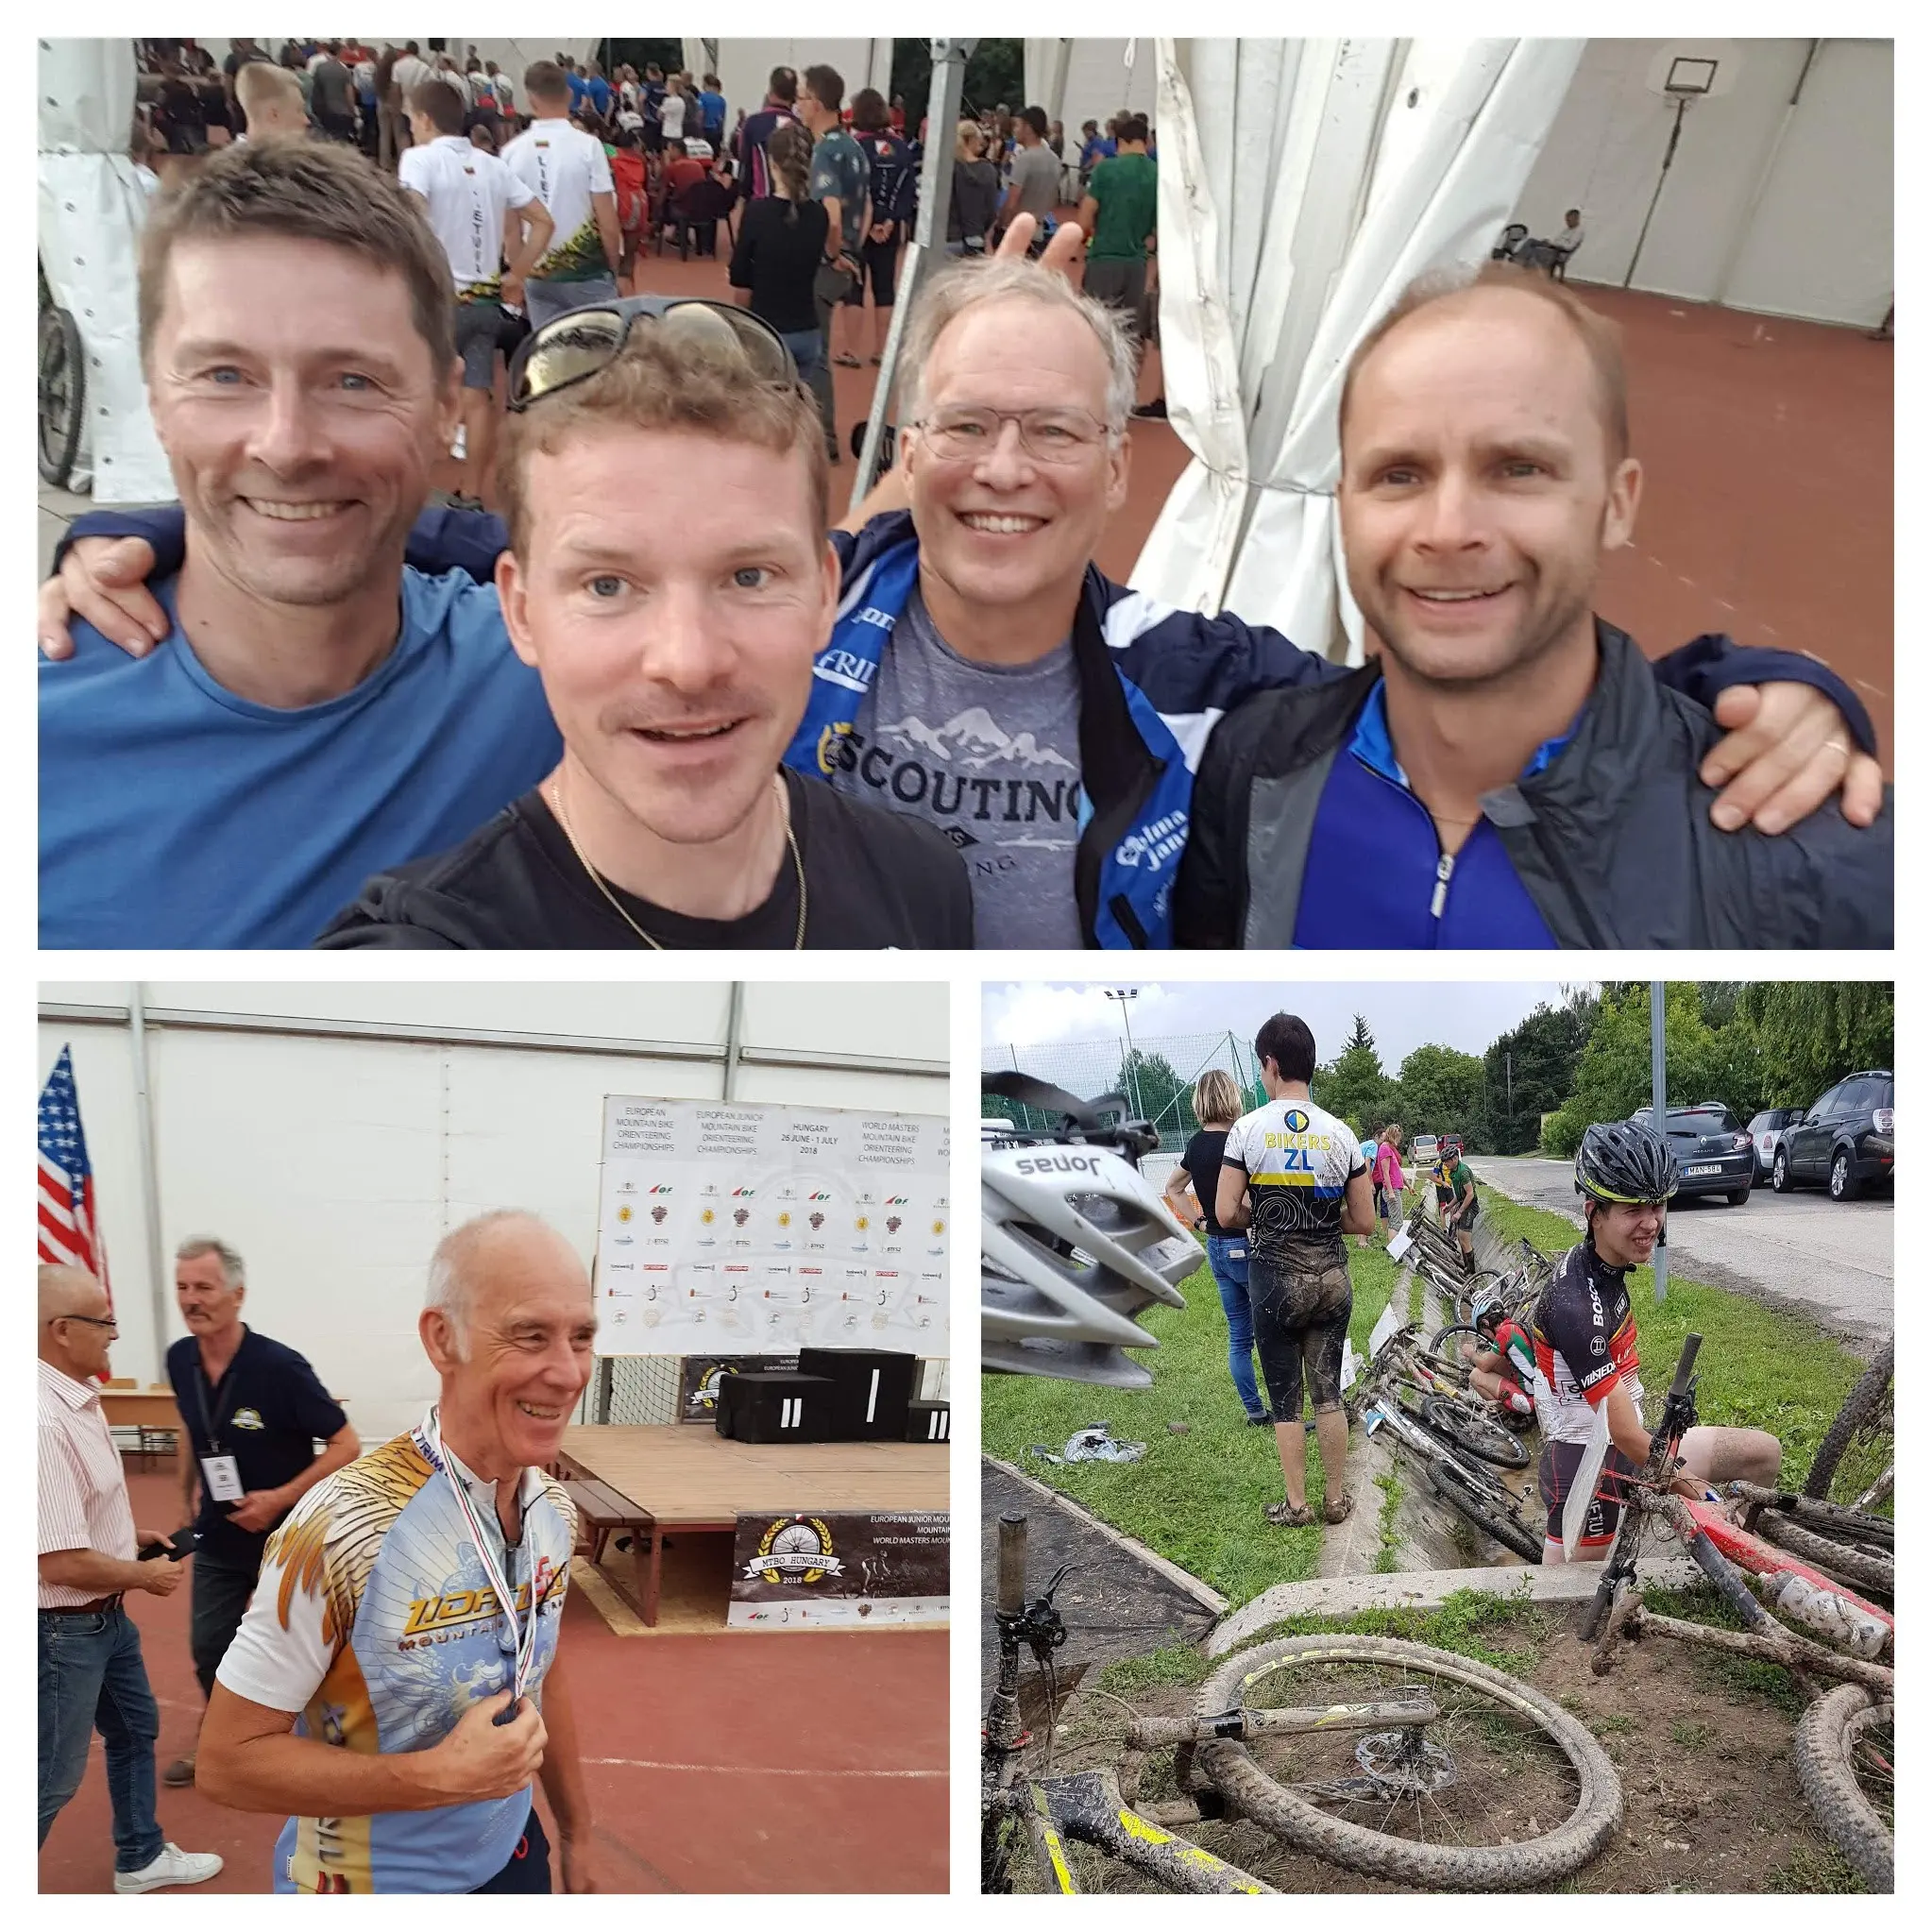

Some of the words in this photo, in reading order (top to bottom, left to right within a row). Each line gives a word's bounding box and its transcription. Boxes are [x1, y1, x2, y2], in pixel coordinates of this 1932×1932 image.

[625, 1107, 667, 1116] EUROPEAN
[696, 1110, 736, 1120] EUROPEAN
[616, 1118, 657, 1127] MOUNTAIN
[658, 1120, 675, 1129] BIKE
[701, 1122, 740, 1131] MOUNTAIN
[741, 1124, 757, 1133] BIKE
[792, 1123, 829, 1133] HUNGARY
[861, 1121, 888, 1131] WORLD
[889, 1124, 920, 1133] MASTERS
[618, 1129, 671, 1140] ORIENTEERING
[703, 1133, 754, 1144] ORIENTEERING
[791, 1135, 810, 1144] JUNE
[821, 1137, 839, 1145] JULY
[862, 1132, 901, 1143] MOUNTAIN
[902, 1135, 917, 1144] BIKE
[613, 1141, 675, 1151] CHAMPIONSHIPS
[1264, 1132, 1331, 1151] BIKERS
[697, 1144, 757, 1155] CHAMPIONSHIPS
[800, 1146, 818, 1155] 2018
[863, 1144, 912, 1154] ORIENTEERING
[858, 1155, 915, 1165] CHAMPIONSHIPS
[1283, 1148, 1314, 1171] ZL
[1586, 1277, 1604, 1328] BOSCH
[762, 1557, 786, 1568] MTBO
[789, 1555, 831, 1568] HUNGARY
[783, 1576, 803, 1585] 2018
